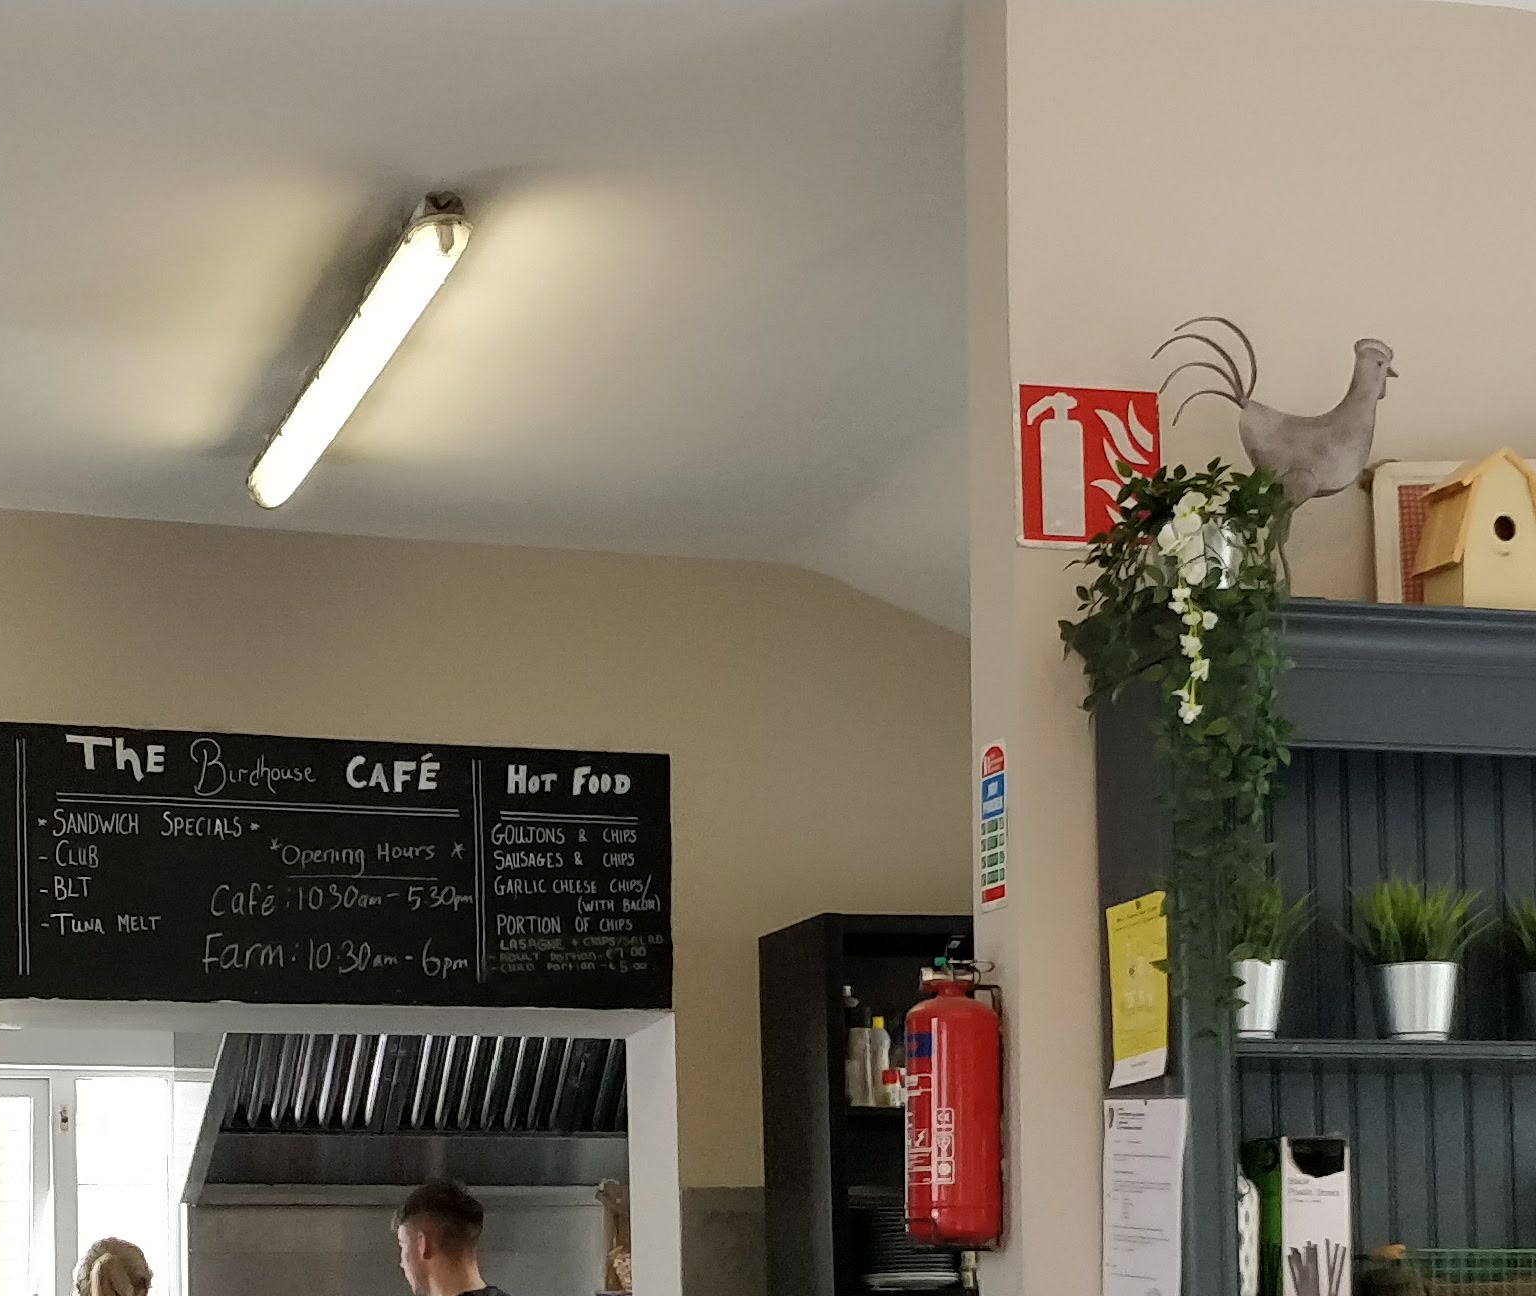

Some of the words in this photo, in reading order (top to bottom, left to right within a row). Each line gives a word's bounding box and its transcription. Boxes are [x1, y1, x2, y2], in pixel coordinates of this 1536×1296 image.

[190, 737, 316, 796] Birdhouse
[345, 752, 441, 793] CAFÉ
[572, 766, 632, 795] FOOD
[52, 808, 140, 837] SANDWICH
[160, 810, 242, 841] SPECIALS
[491, 823, 566, 846] GOUJONS
[602, 828, 637, 844] CHIPS
[55, 840, 99, 868] CLUB
[376, 842, 436, 861] Hours
[494, 850, 565, 870] SAUSAGES
[602, 852, 636, 867] CHIPS
[53, 875, 92, 900] BLT
[494, 876, 548, 896] GARLIC
[553, 879, 598, 894] CHEESE
[117, 914, 162, 933] MELT
[497, 914, 562, 936] PORTION
[575, 916, 591, 933] OF
[599, 917, 634, 931] CHIPS
